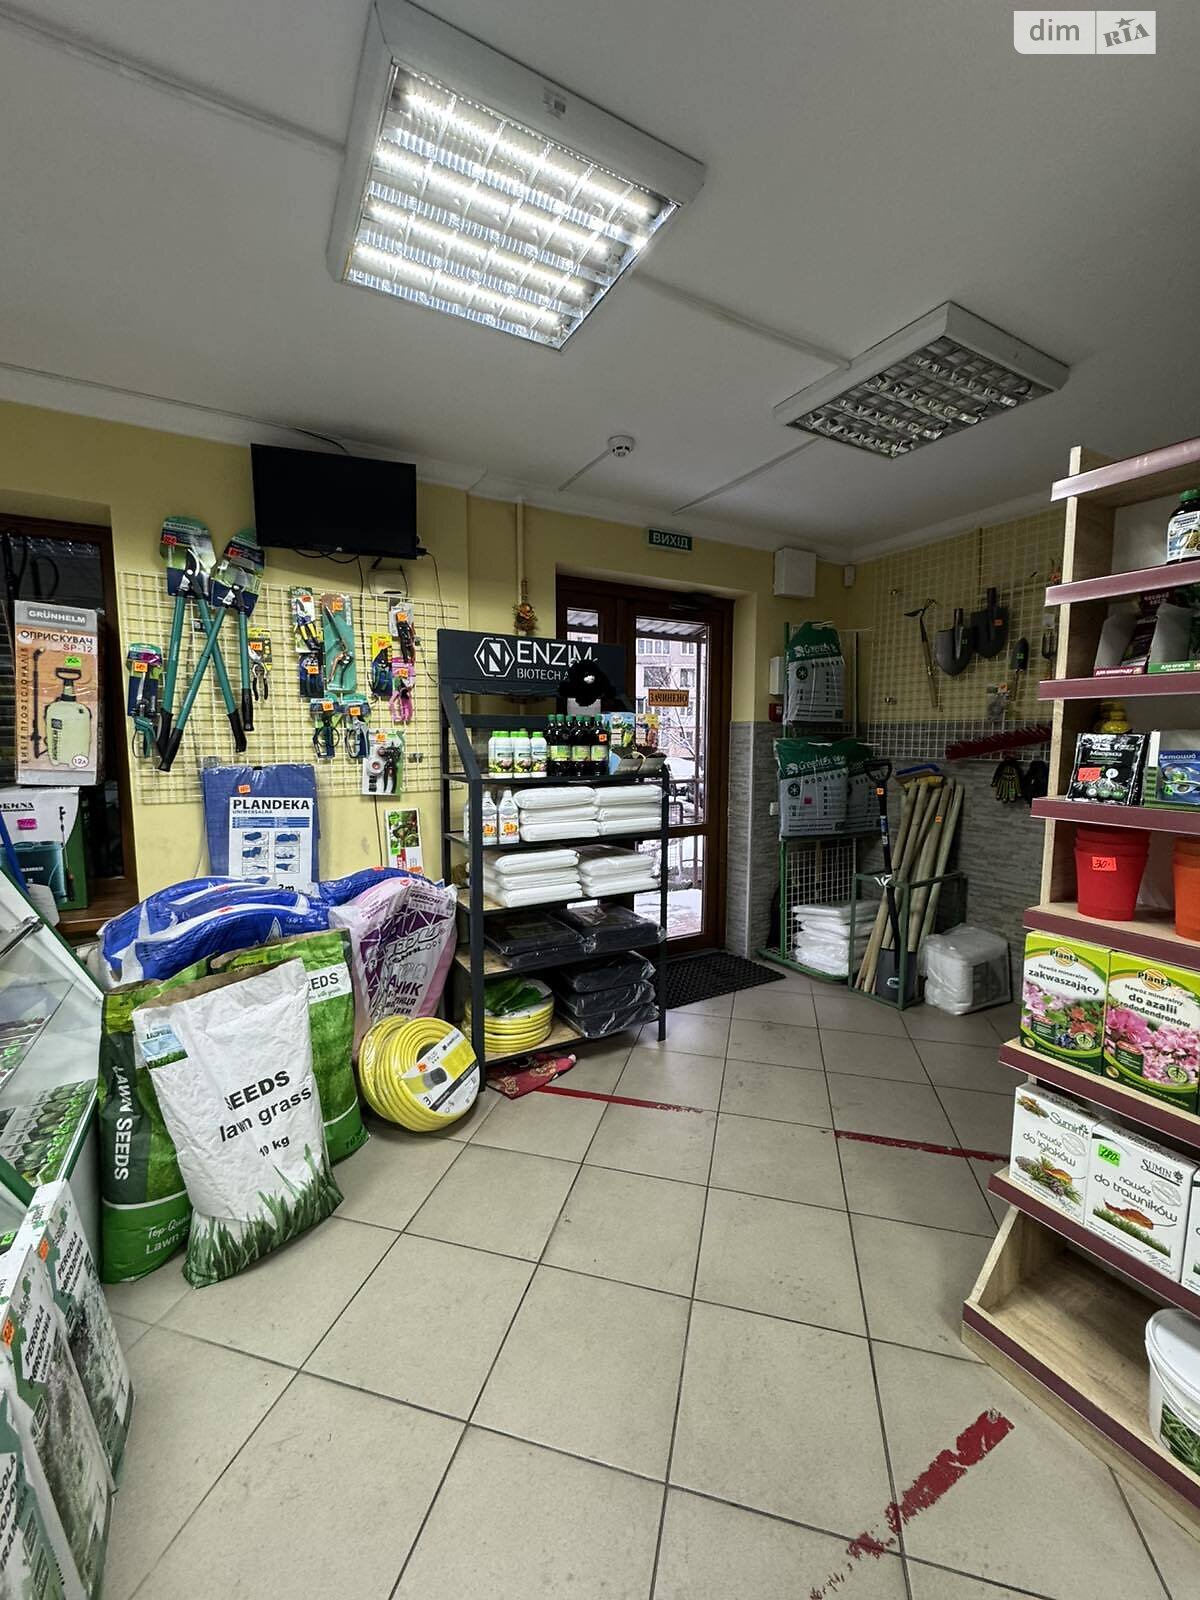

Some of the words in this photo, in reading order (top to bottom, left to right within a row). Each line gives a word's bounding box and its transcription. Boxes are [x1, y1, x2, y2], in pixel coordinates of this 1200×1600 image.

[652, 532, 689, 549] ВИХІД
[27, 608, 87, 624] GRÜNHELM
[20, 630, 94, 646] ОПРИСКУВАЧ
[62, 643, 94, 654] SP-12
[516, 639, 594, 666] ENZIM
[516, 668, 562, 681] BIOTECH
[232, 799, 310, 811] PLANDEKA
[1050, 948, 1079, 963] Planta
[1027, 968, 1100, 996] zakwaszający
[1136, 971, 1172, 988] Planta
[1128, 993, 1144, 1005] do
[1145, 998, 1178, 1016] azalii
[1147, 990, 1184, 1007] mineralny
[112, 1065, 133, 1113] LAWN
[258, 1086, 313, 1127] grass
[272, 1134, 291, 1151] kg
[1022, 1132, 1037, 1145] do
[1036, 1130, 1063, 1149] nawóz
[113, 1117, 133, 1181] SEEDS
[1140, 1157, 1173, 1177] SUMIN
[1118, 1174, 1153, 1197] nawóz
[1094, 1173, 1110, 1187] do
[1112, 1181, 1178, 1223] trawników
[145, 1234, 181, 1255] Lawn
[56, 1231, 79, 1281] PERGOLA
[24, 1304, 46, 1367] PERGOLA
